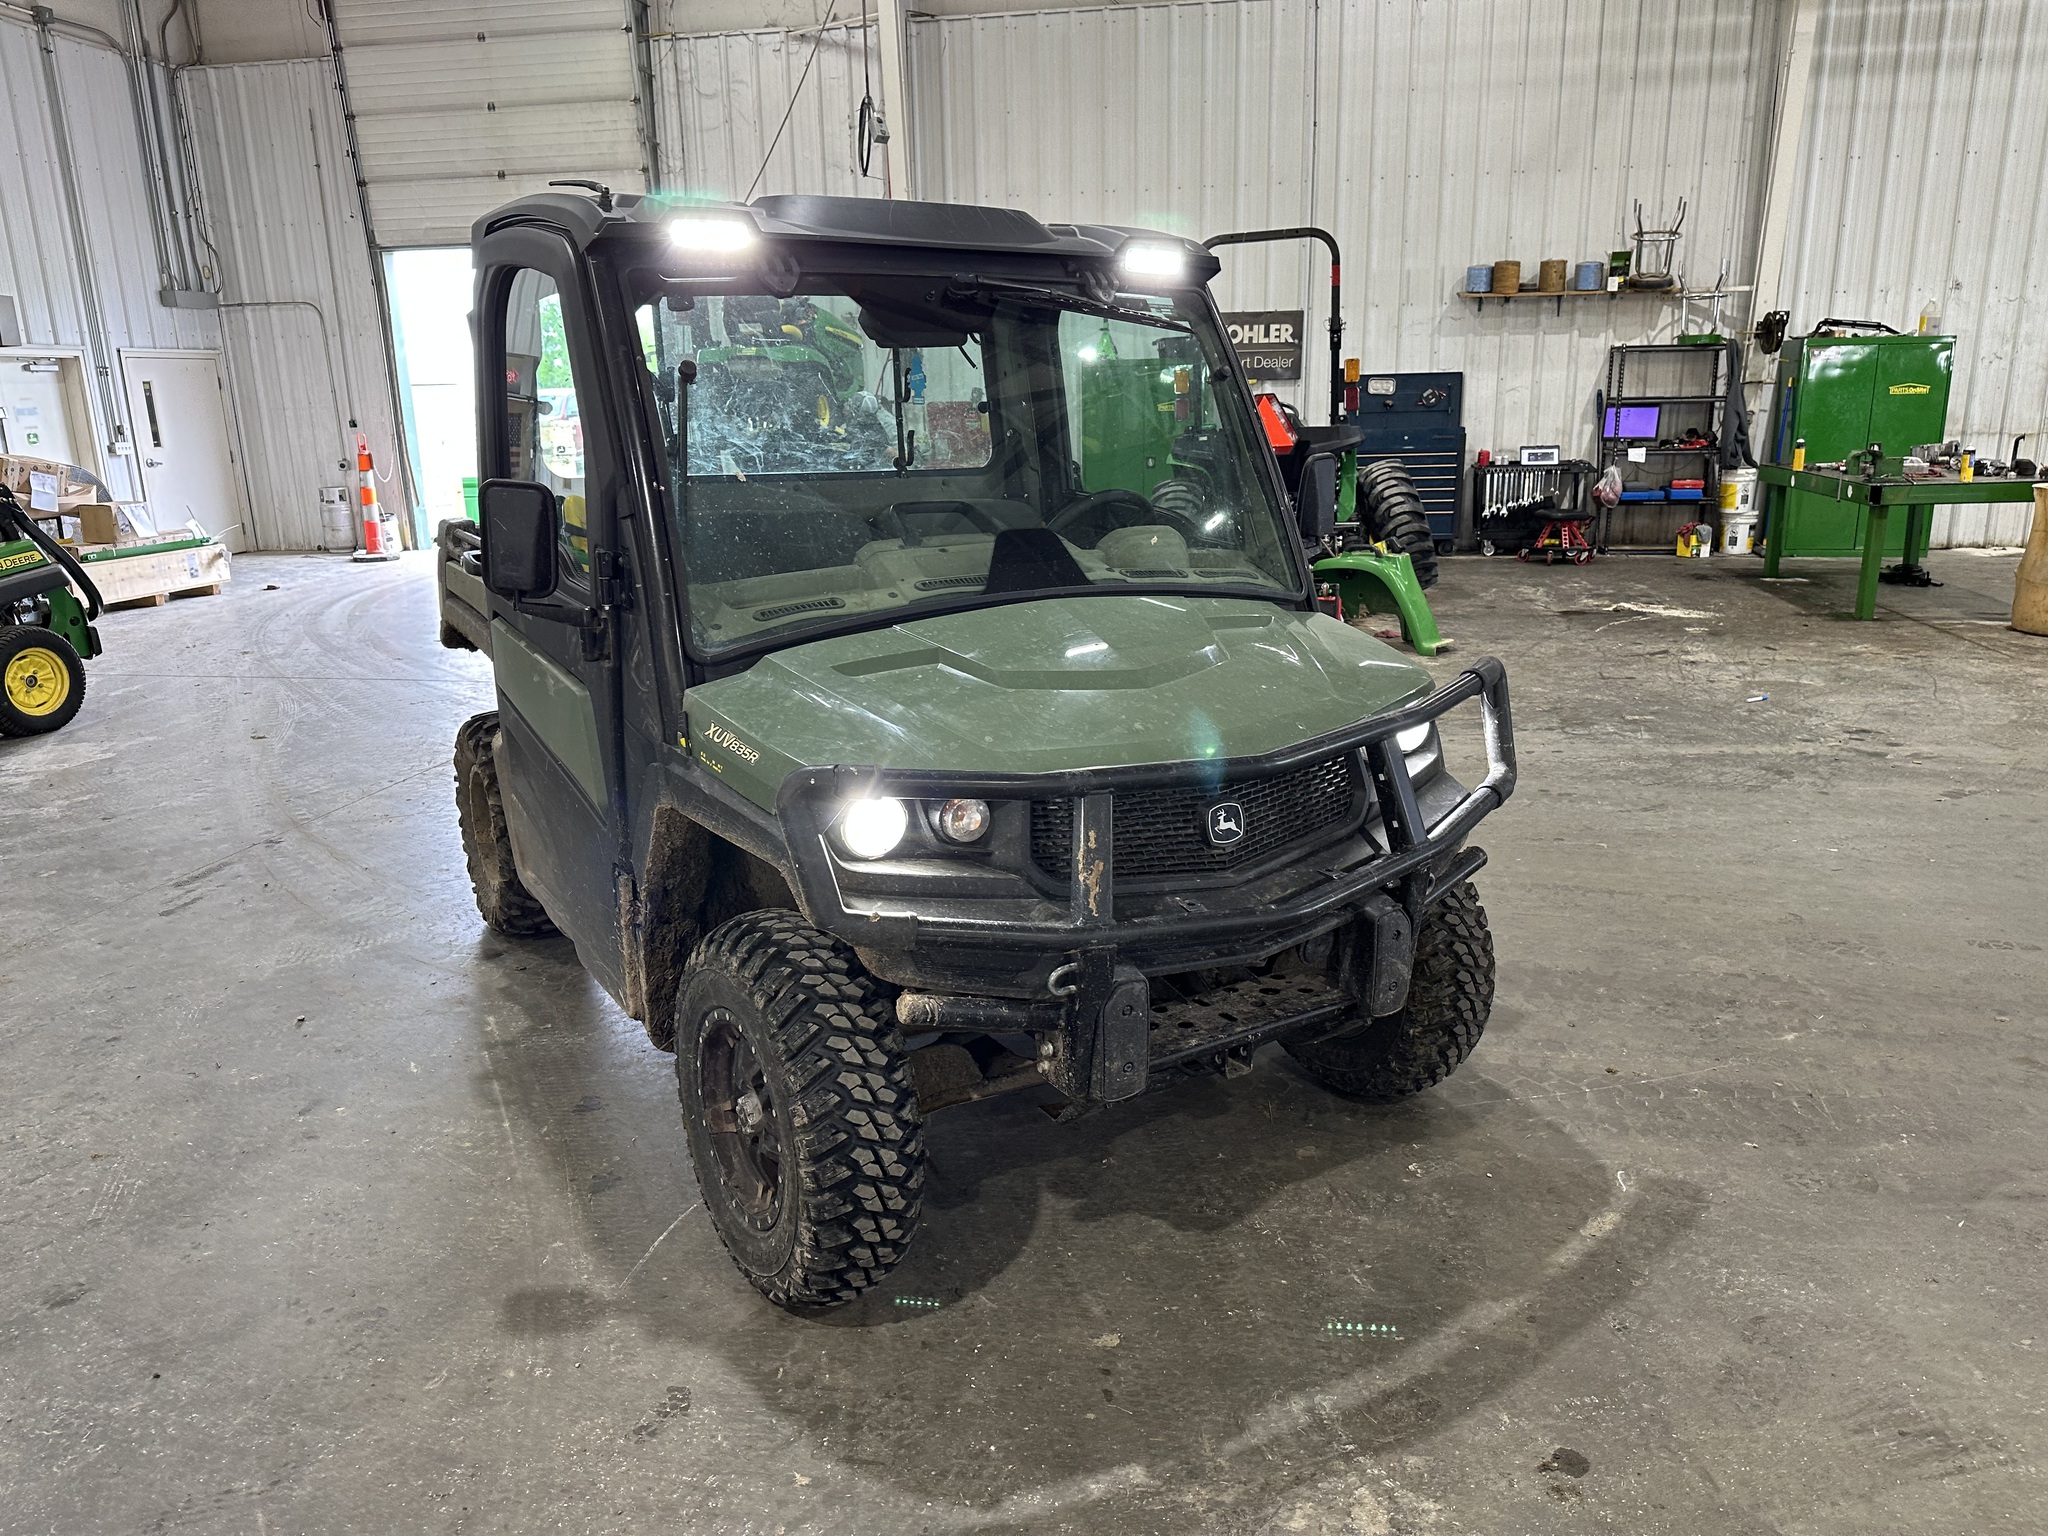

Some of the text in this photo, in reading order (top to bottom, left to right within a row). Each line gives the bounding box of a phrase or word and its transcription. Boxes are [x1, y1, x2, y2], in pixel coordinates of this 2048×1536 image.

[1225, 324, 1294, 344] OHLER
[1254, 355, 1294, 369] Dealer
[4, 554, 37, 569] DEERE
[704, 722, 759, 764] XUV835R
